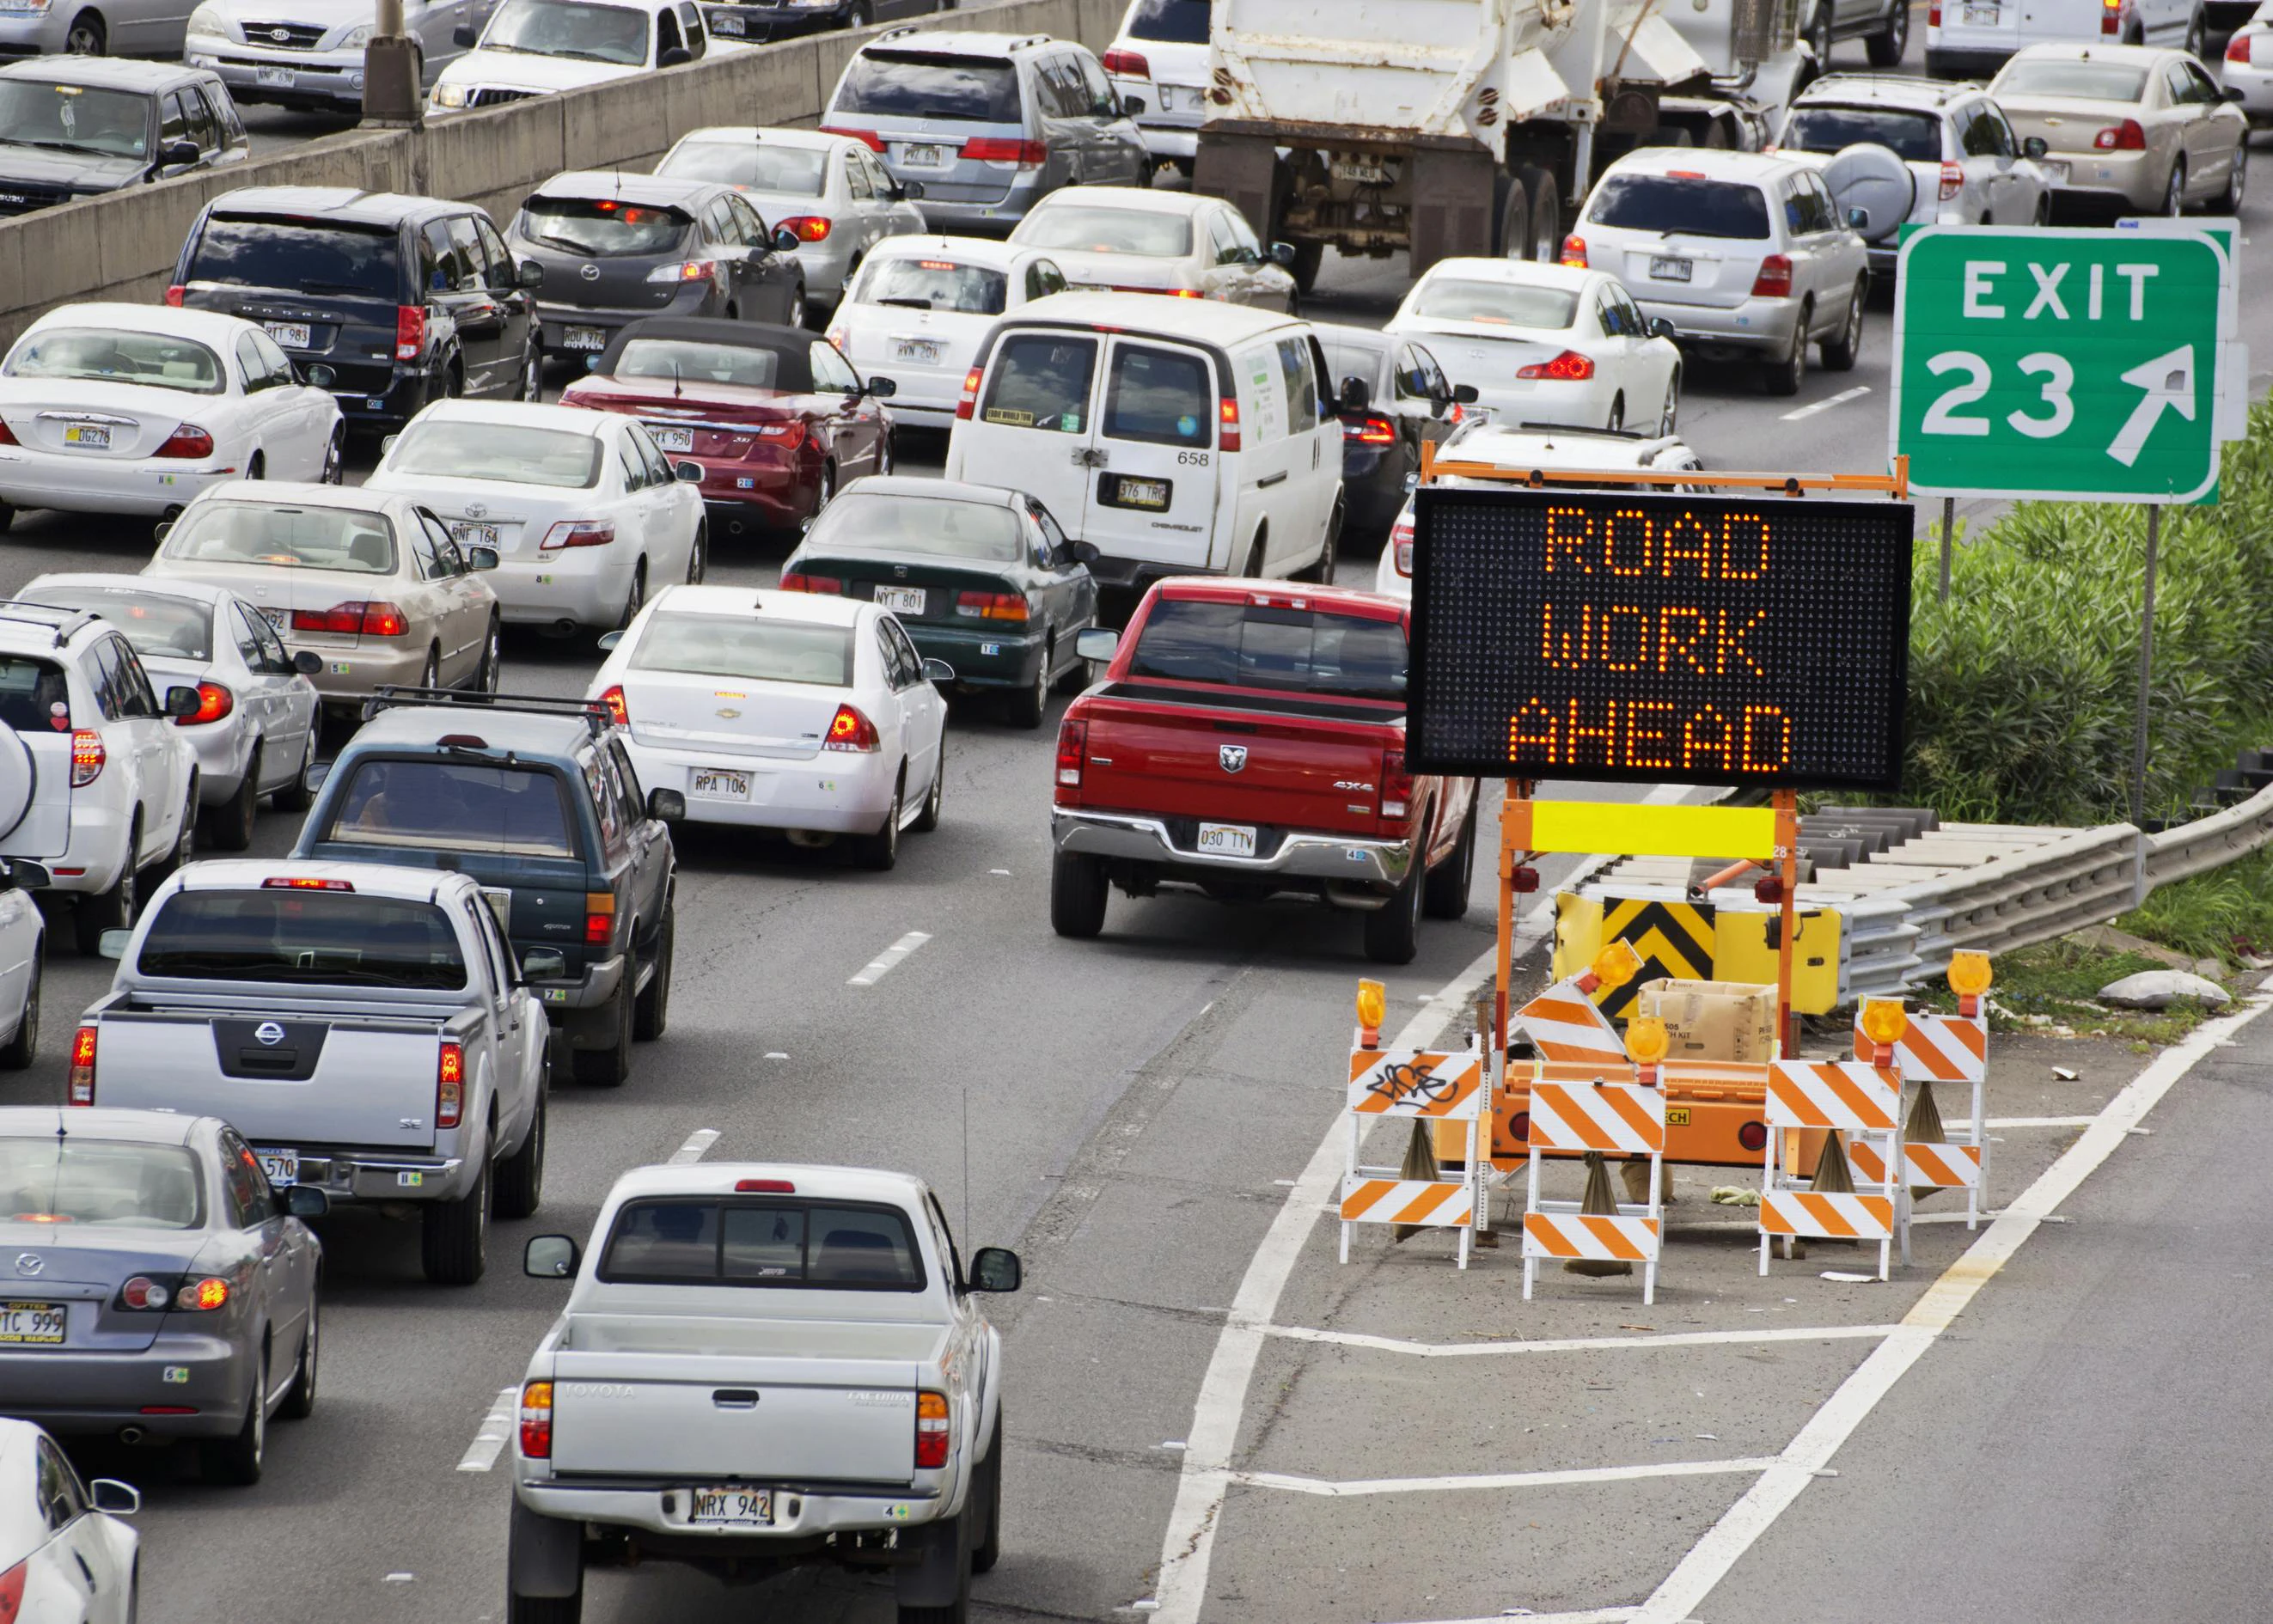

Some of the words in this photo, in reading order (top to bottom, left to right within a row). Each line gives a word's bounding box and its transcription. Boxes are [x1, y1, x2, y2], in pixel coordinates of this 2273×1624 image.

[1963, 260, 2160, 321] EXIT
[289, 328, 308, 343] 983
[1921, 351, 2074, 439] 23
[673, 432, 691, 446] 950
[1177, 451, 1209, 467] 658
[1120, 483, 1140, 498] 376
[453, 527, 473, 542] RNF
[1151, 522, 1204, 533] CHEVROLET
[1545, 506, 1770, 581] ROAD
[876, 591, 897, 607] NYT
[902, 594, 922, 608] 801
[1541, 602, 1767, 677] WORK
[1508, 697, 1793, 773] AHEAD
[696, 775, 718, 791] RPA
[725, 778, 747, 793] 106
[1201, 830, 1224, 846] 030
[1231, 832, 1254, 850] TTV
[400, 1118, 423, 1129] SE
[266, 1157, 294, 1177] 570
[33, 1313, 64, 1334] 999
[564, 1383, 635, 1399] TOYOTA
[695, 1494, 727, 1517] NRX
[737, 1495, 768, 1517] 942
